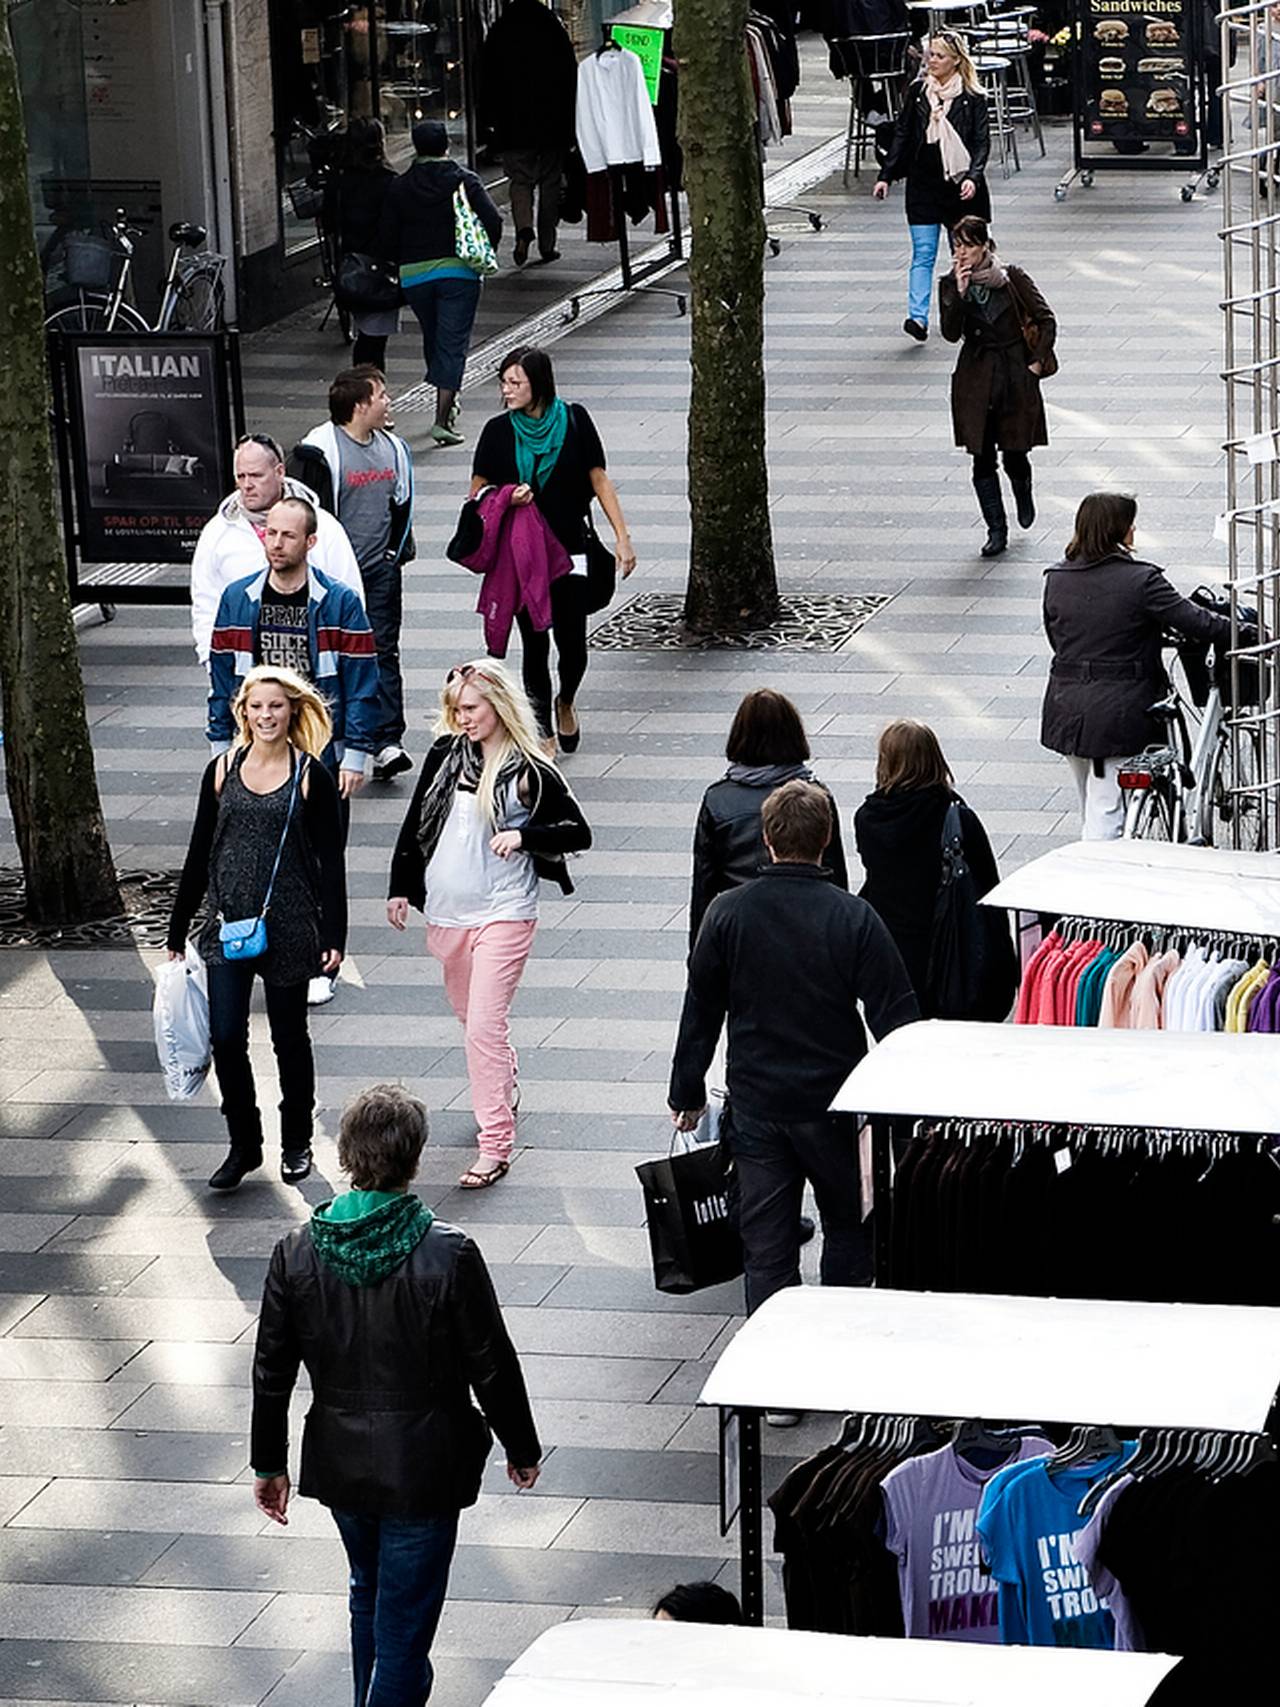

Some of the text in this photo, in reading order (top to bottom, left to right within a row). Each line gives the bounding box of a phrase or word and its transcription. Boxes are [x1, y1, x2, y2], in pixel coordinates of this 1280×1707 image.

[1090, 0, 1182, 12] Sandwiches
[91, 355, 200, 377] ITALIAN
[103, 516, 137, 527] SPAR
[139, 516, 160, 527] OP
[261, 604, 308, 628] PEAK
[261, 632, 308, 651] SINCE
[932, 1508, 975, 1548] I'M
